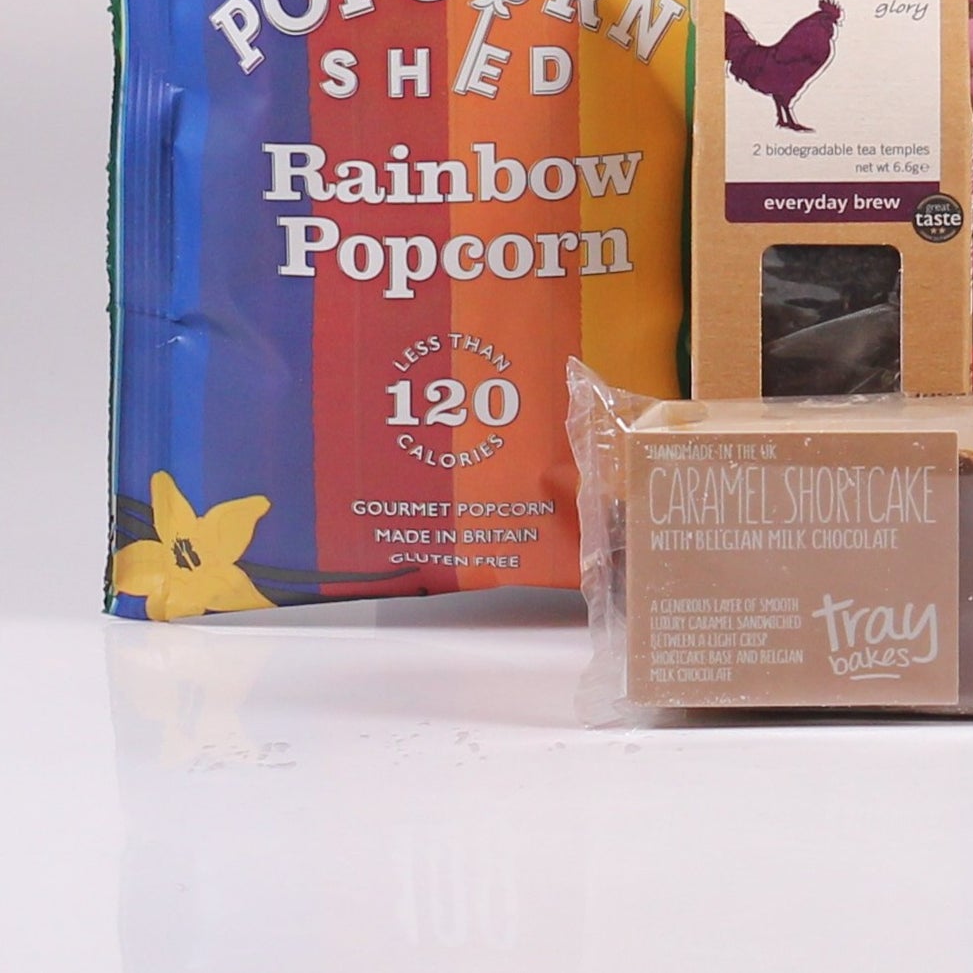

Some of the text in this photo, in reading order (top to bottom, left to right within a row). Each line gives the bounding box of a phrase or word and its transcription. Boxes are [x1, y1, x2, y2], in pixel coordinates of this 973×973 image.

[875, 0, 929, 21] glory
[320, 45, 573, 99] SHED
[752, 143, 930, 158] 2 biodegradable tea temples
[262, 142, 643, 205] Rainbow
[855, 162, 873, 173] net
[876, 162, 890, 173] wt
[764, 194, 901, 214] everyday brew
[915, 213, 962, 227] taste
[277, 216, 635, 300] Popcorn
[392, 333, 511, 373] LESS THAN
[385, 378, 521, 427] 120
[396, 433, 505, 469] CALORIES
[649, 444, 777, 460] HANDMADE IN THE UK
[650, 465, 937, 525] CARAMEL SHORTCAKE
[352, 500, 555, 518] GOURMET POPCORN
[375, 527, 538, 544] MADE IN BRITAIN
[650, 528, 899, 551] WITH BELGIAN MILK CHOCOLATE
[390, 553, 520, 568] GLUTEN FREE
[650, 599, 658, 613] A
[760, 597, 799, 612] SMOOTH
[812, 593, 938, 663] tray
[736, 649, 758, 664] AND
[828, 647, 910, 676] bakes
